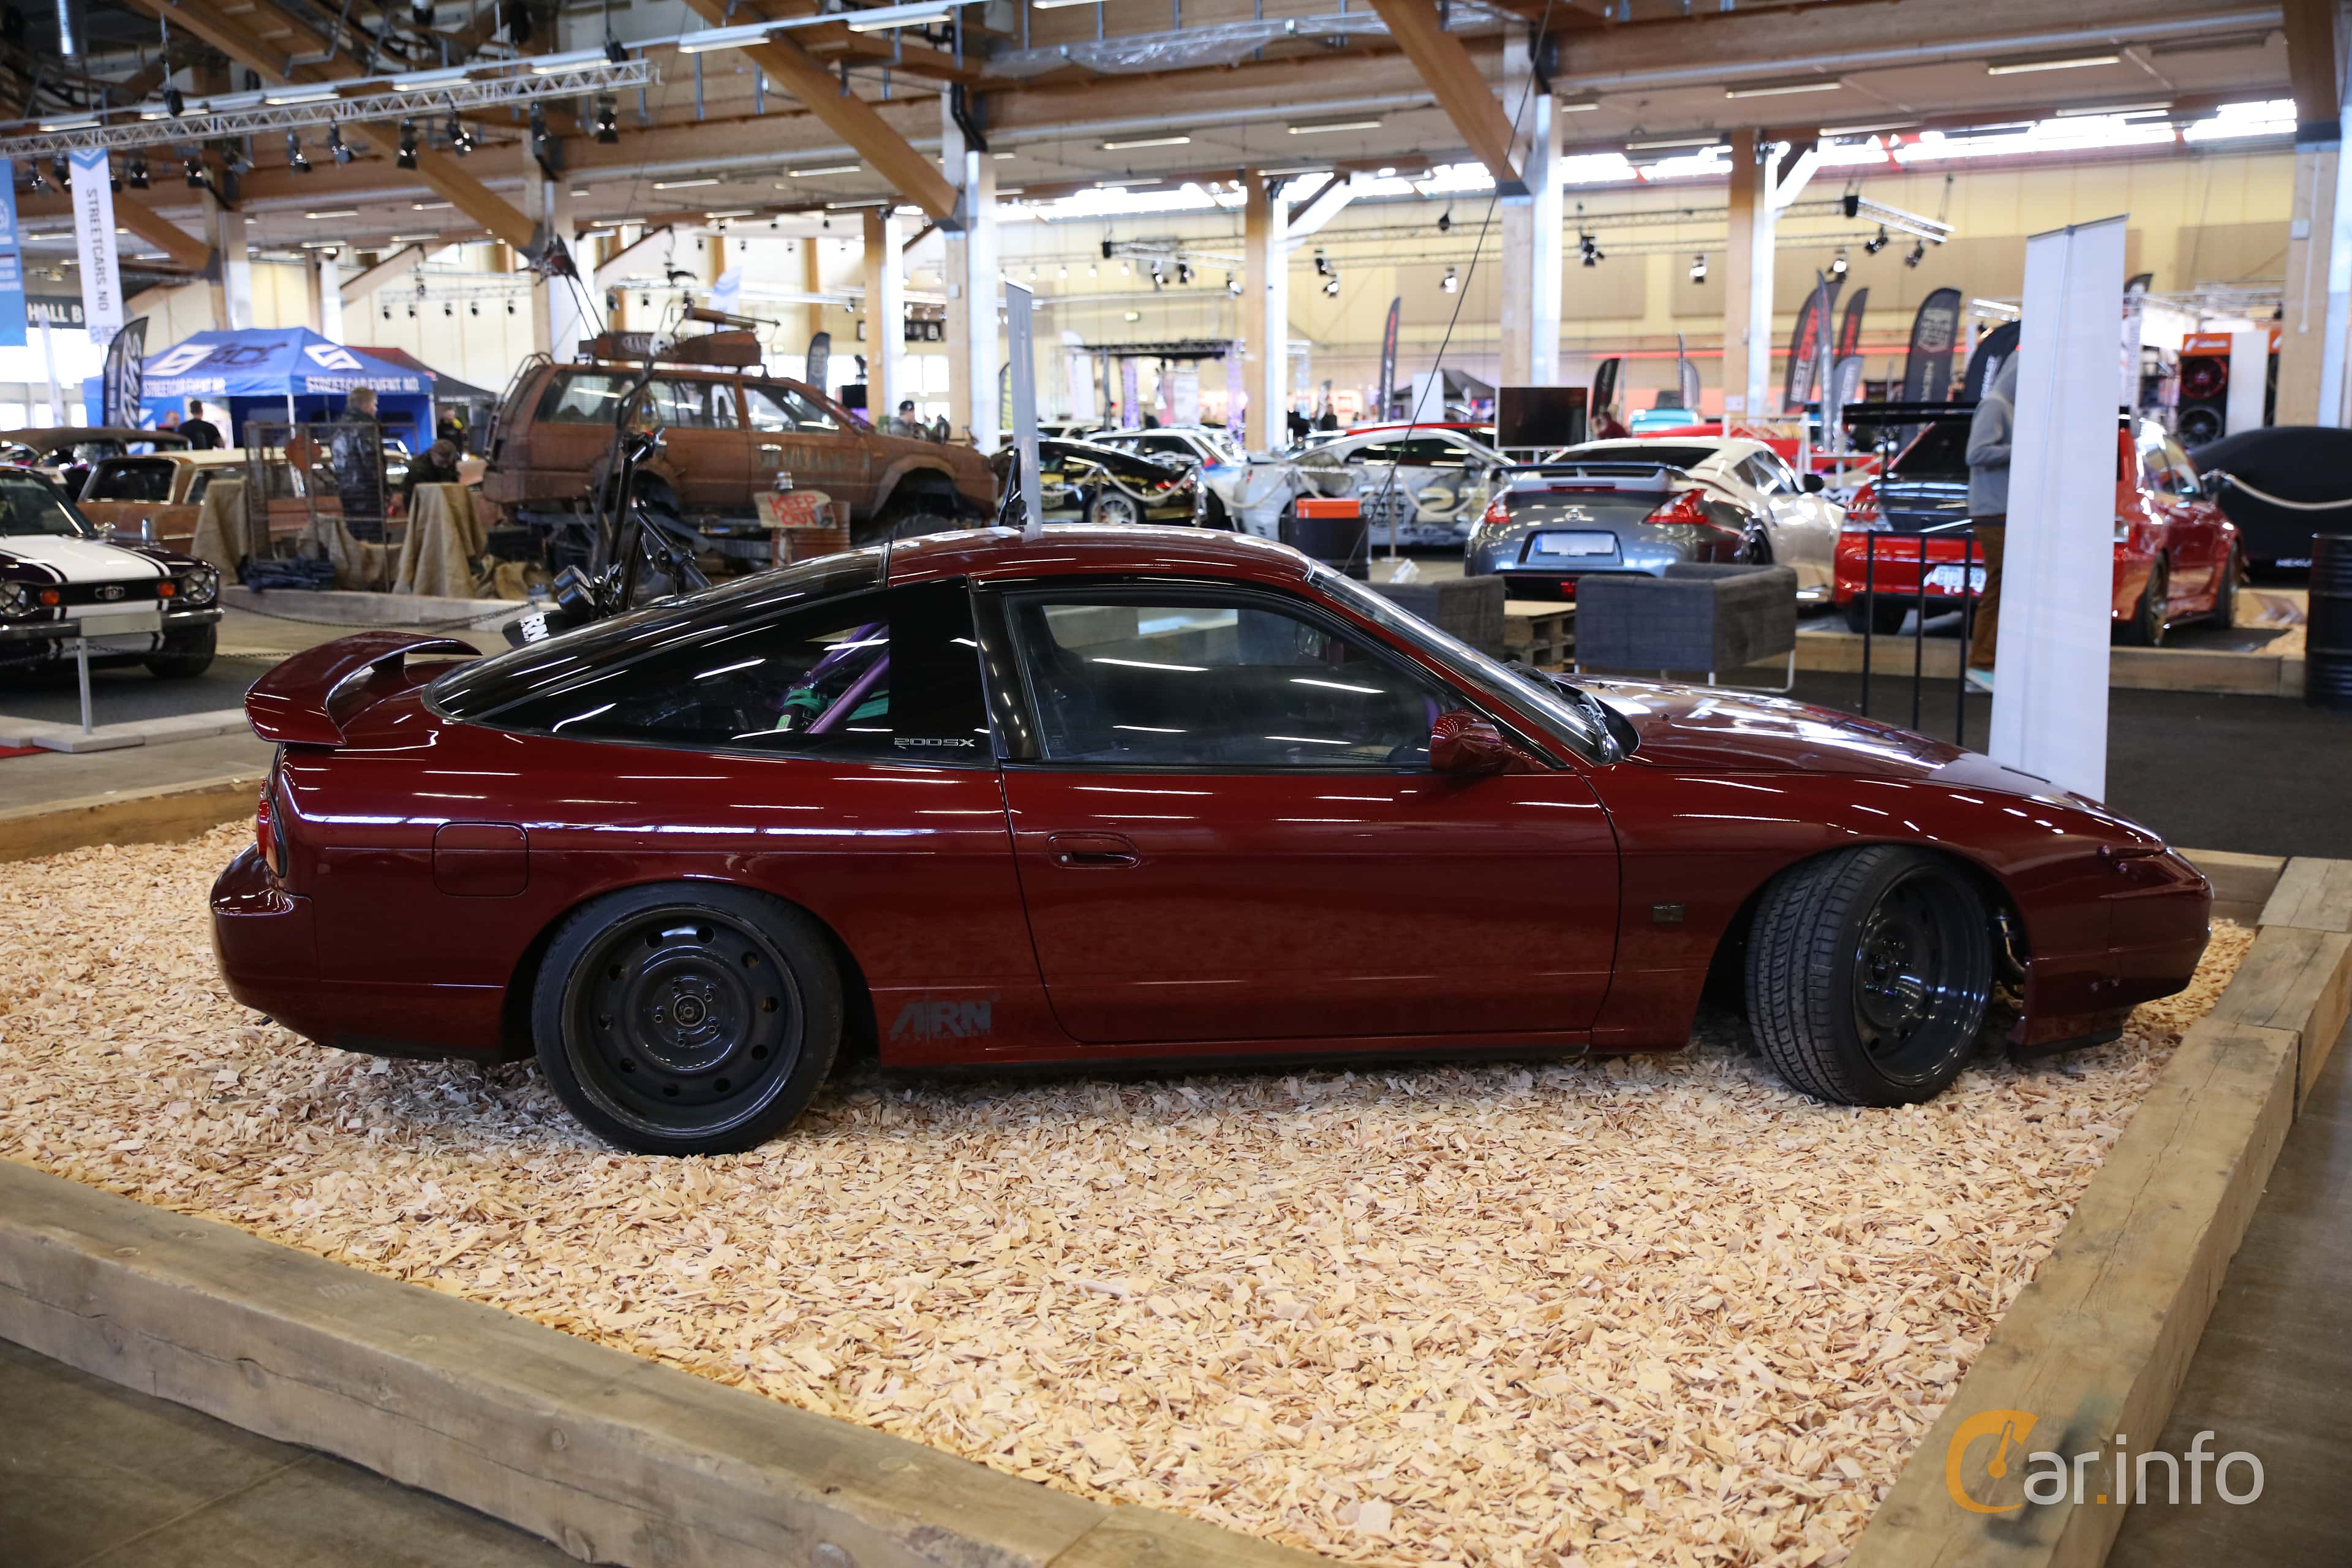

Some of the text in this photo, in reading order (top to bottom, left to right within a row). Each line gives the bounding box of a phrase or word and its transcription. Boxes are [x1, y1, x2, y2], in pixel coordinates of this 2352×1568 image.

[767, 493, 818, 519] KEEP
[782, 511, 818, 526] OUT
[894, 737, 975, 747] 200SX
